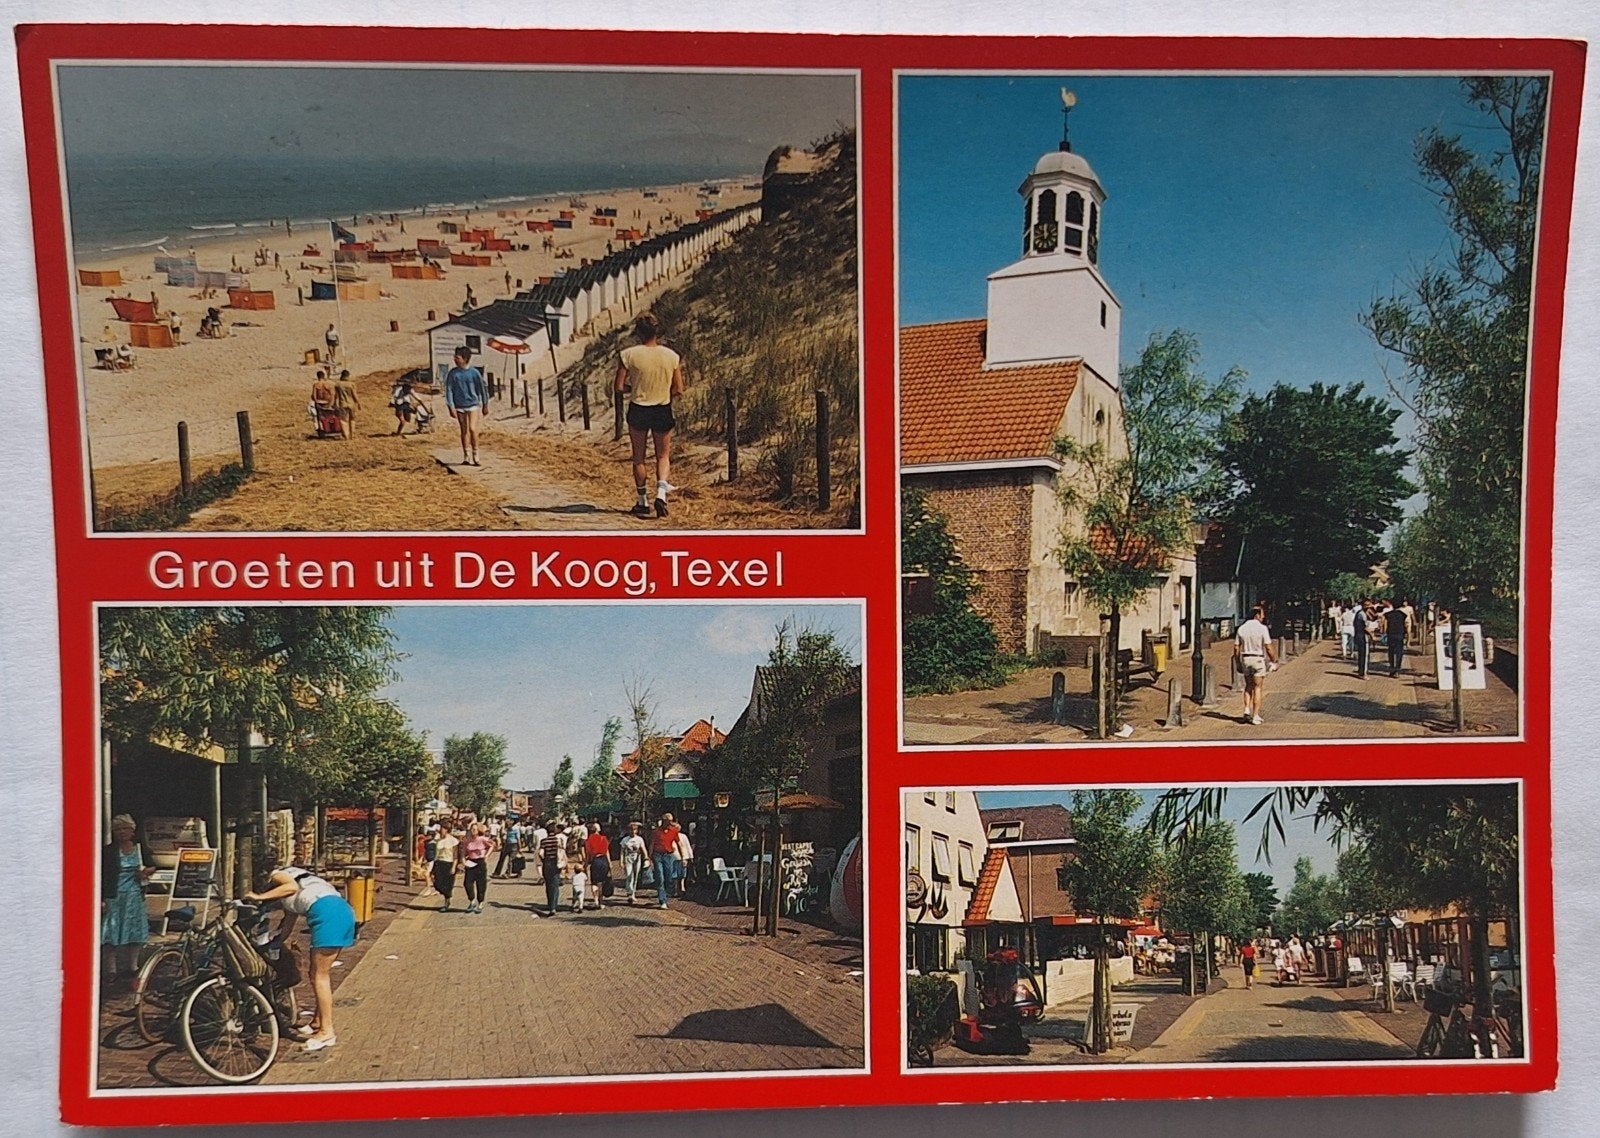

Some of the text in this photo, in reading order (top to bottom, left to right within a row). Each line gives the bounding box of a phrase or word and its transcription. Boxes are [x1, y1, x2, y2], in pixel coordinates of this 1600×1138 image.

[148, 550, 355, 589] Groeten
[376, 551, 434, 588] uit
[454, 551, 516, 588] De
